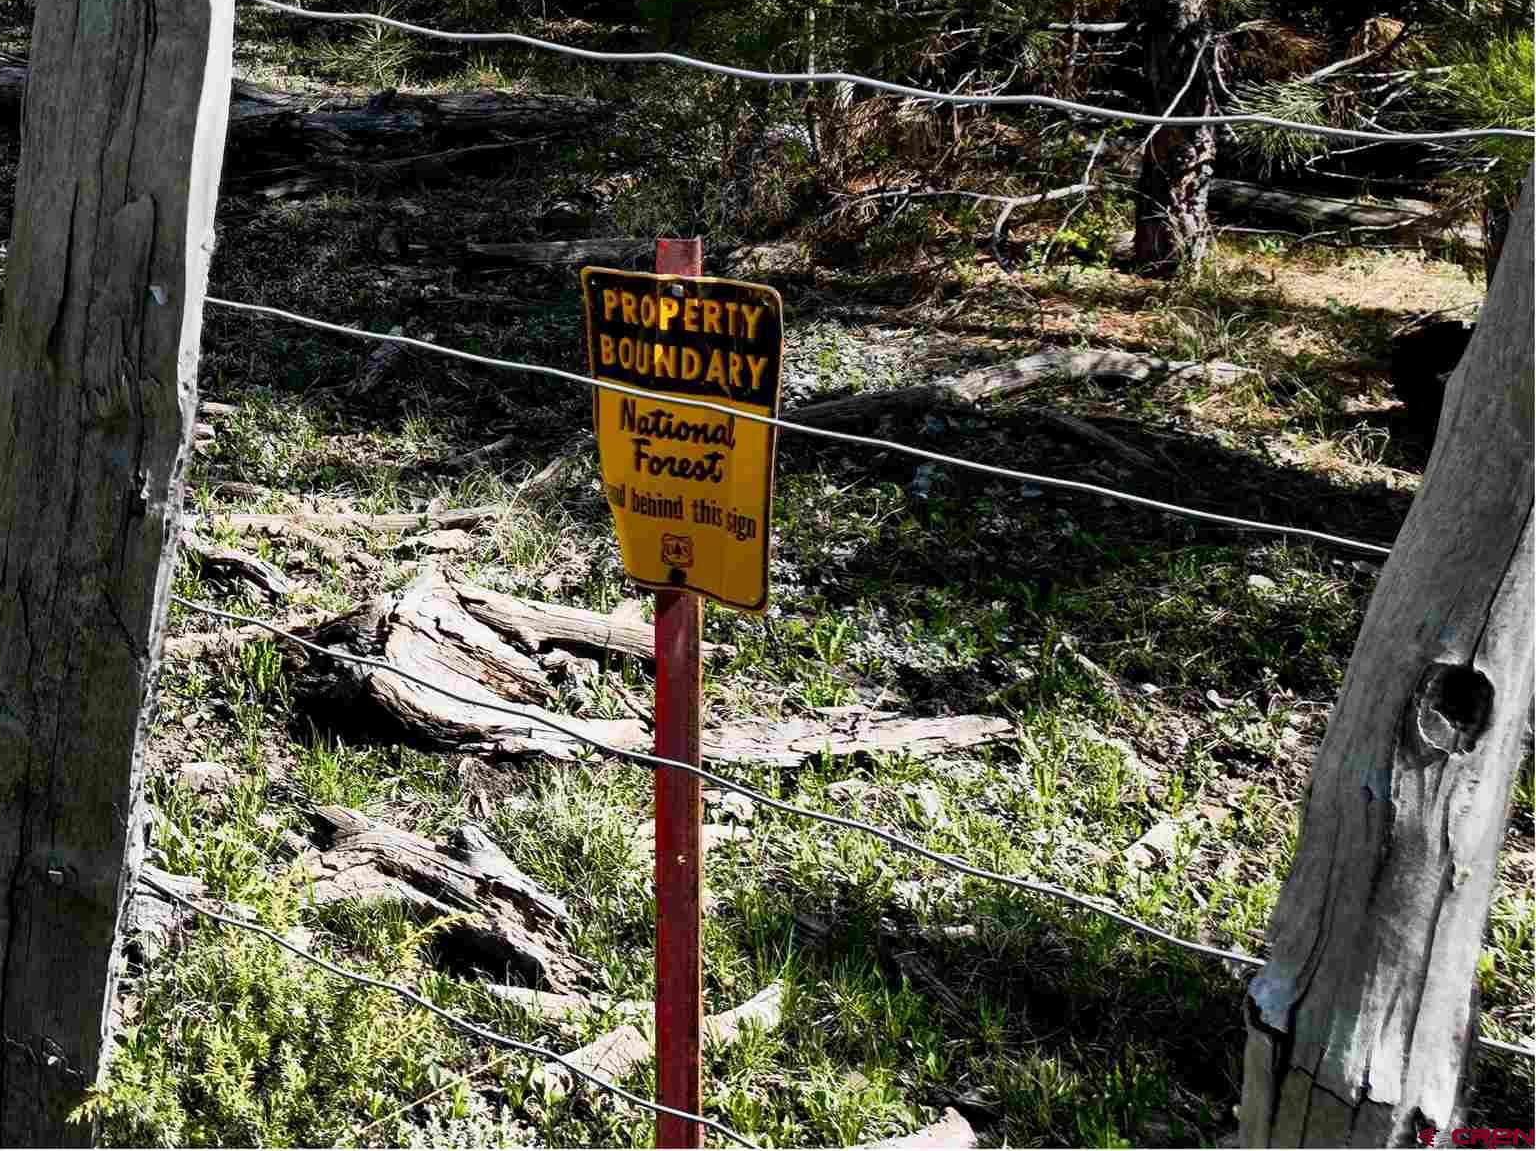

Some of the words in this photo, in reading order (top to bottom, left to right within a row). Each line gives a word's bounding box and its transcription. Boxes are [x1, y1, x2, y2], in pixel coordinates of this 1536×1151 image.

[602, 288, 763, 339] PROPERTY
[599, 333, 768, 389] BOUNDARY
[620, 397, 736, 450] National
[632, 437, 724, 483] Forest
[631, 486, 684, 520] behind
[691, 498, 723, 527] this
[727, 507, 756, 541] sign
